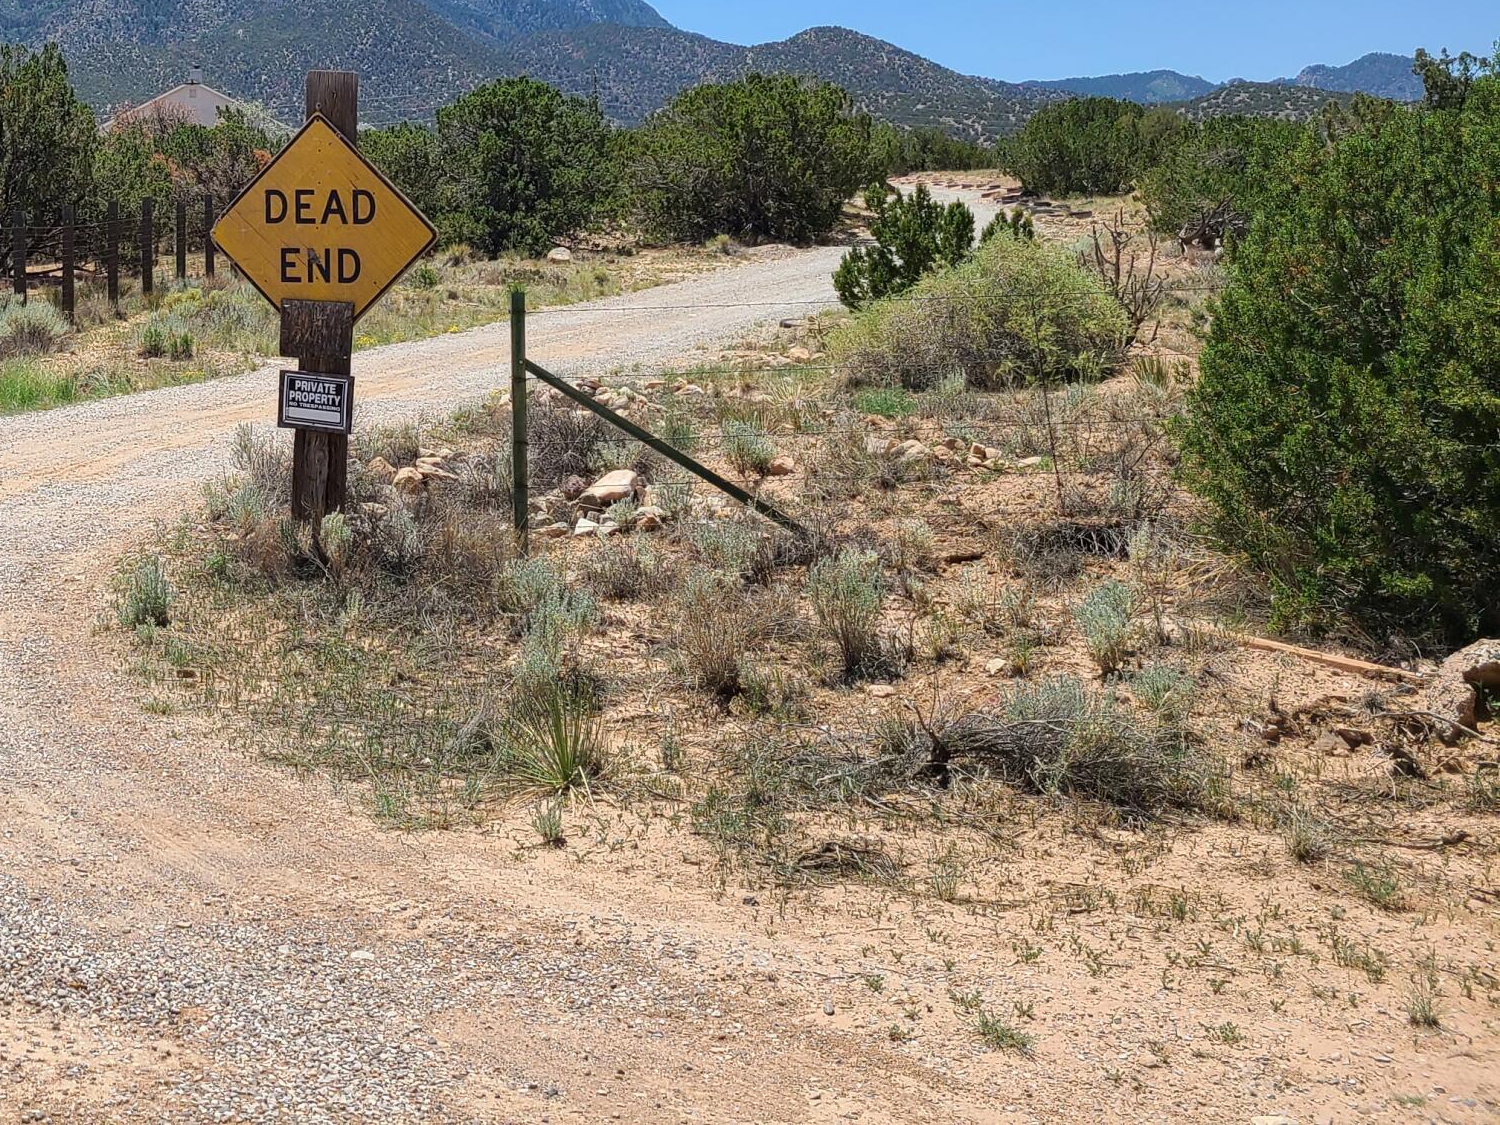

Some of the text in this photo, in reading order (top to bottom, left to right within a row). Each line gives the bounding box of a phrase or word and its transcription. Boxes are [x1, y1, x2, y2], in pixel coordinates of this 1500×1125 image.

[265, 190, 376, 224] DEAD
[280, 248, 361, 284] END
[295, 380, 337, 394] PRIVATE
[289, 391, 341, 406] PROPERTY
[299, 402, 341, 411] TRESPASSING
